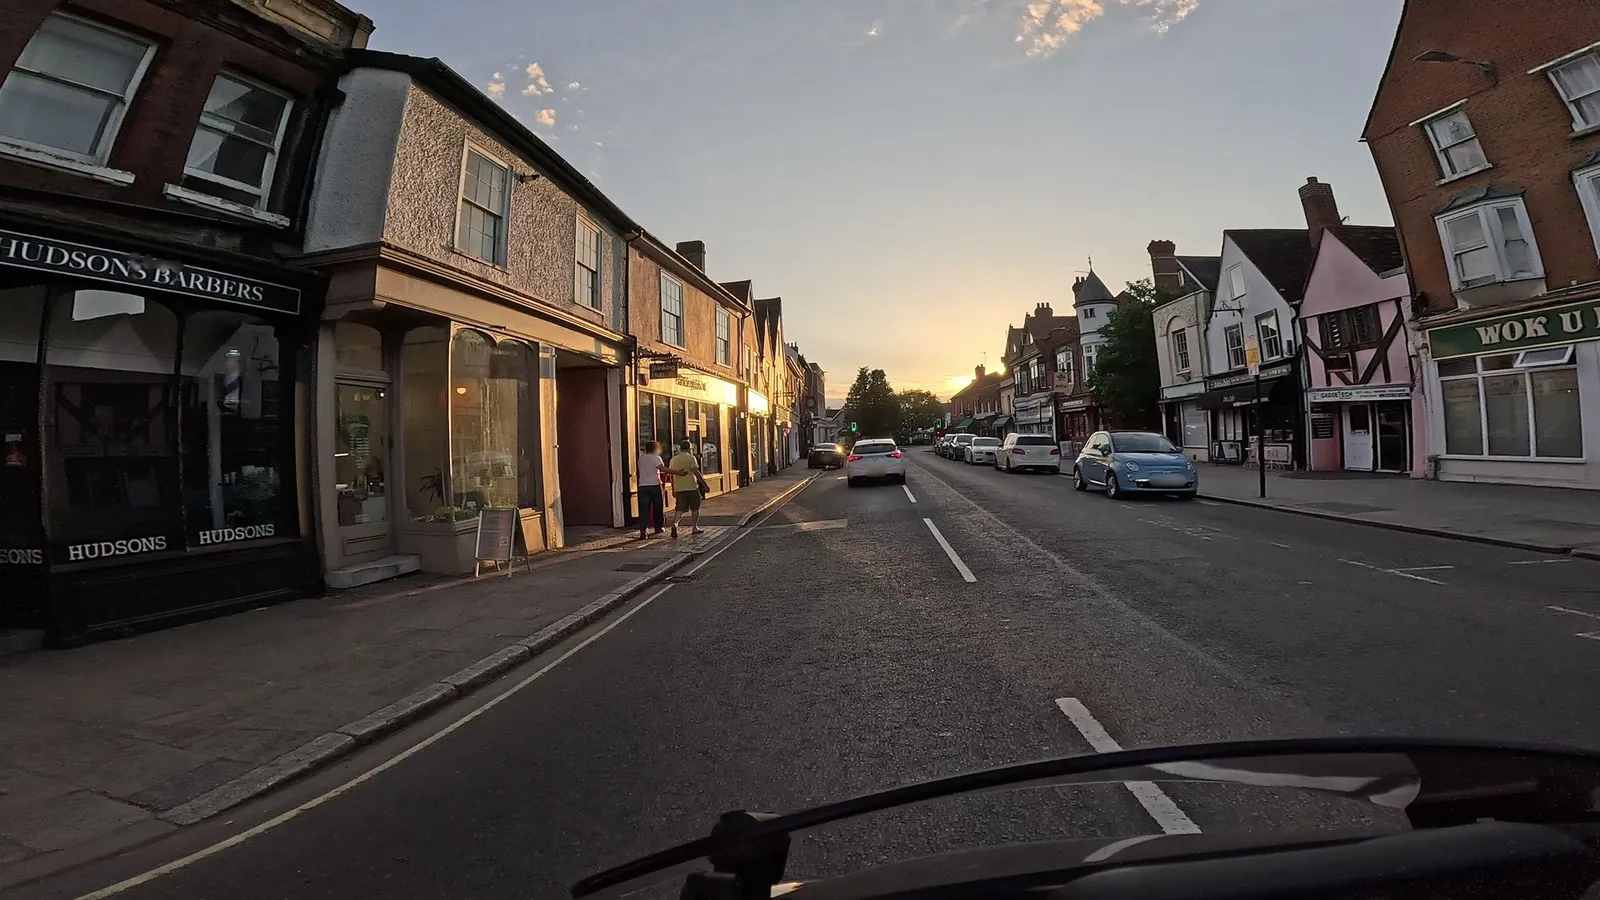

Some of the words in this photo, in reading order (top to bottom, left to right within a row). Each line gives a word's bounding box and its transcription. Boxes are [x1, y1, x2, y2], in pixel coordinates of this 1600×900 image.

[152, 265, 264, 301] BARBERS
[1476, 316, 1549, 345] WOK
[1559, 310, 1584, 333] U
[68, 536, 167, 561] HUDSONS
[199, 524, 275, 544] HUDSONS
